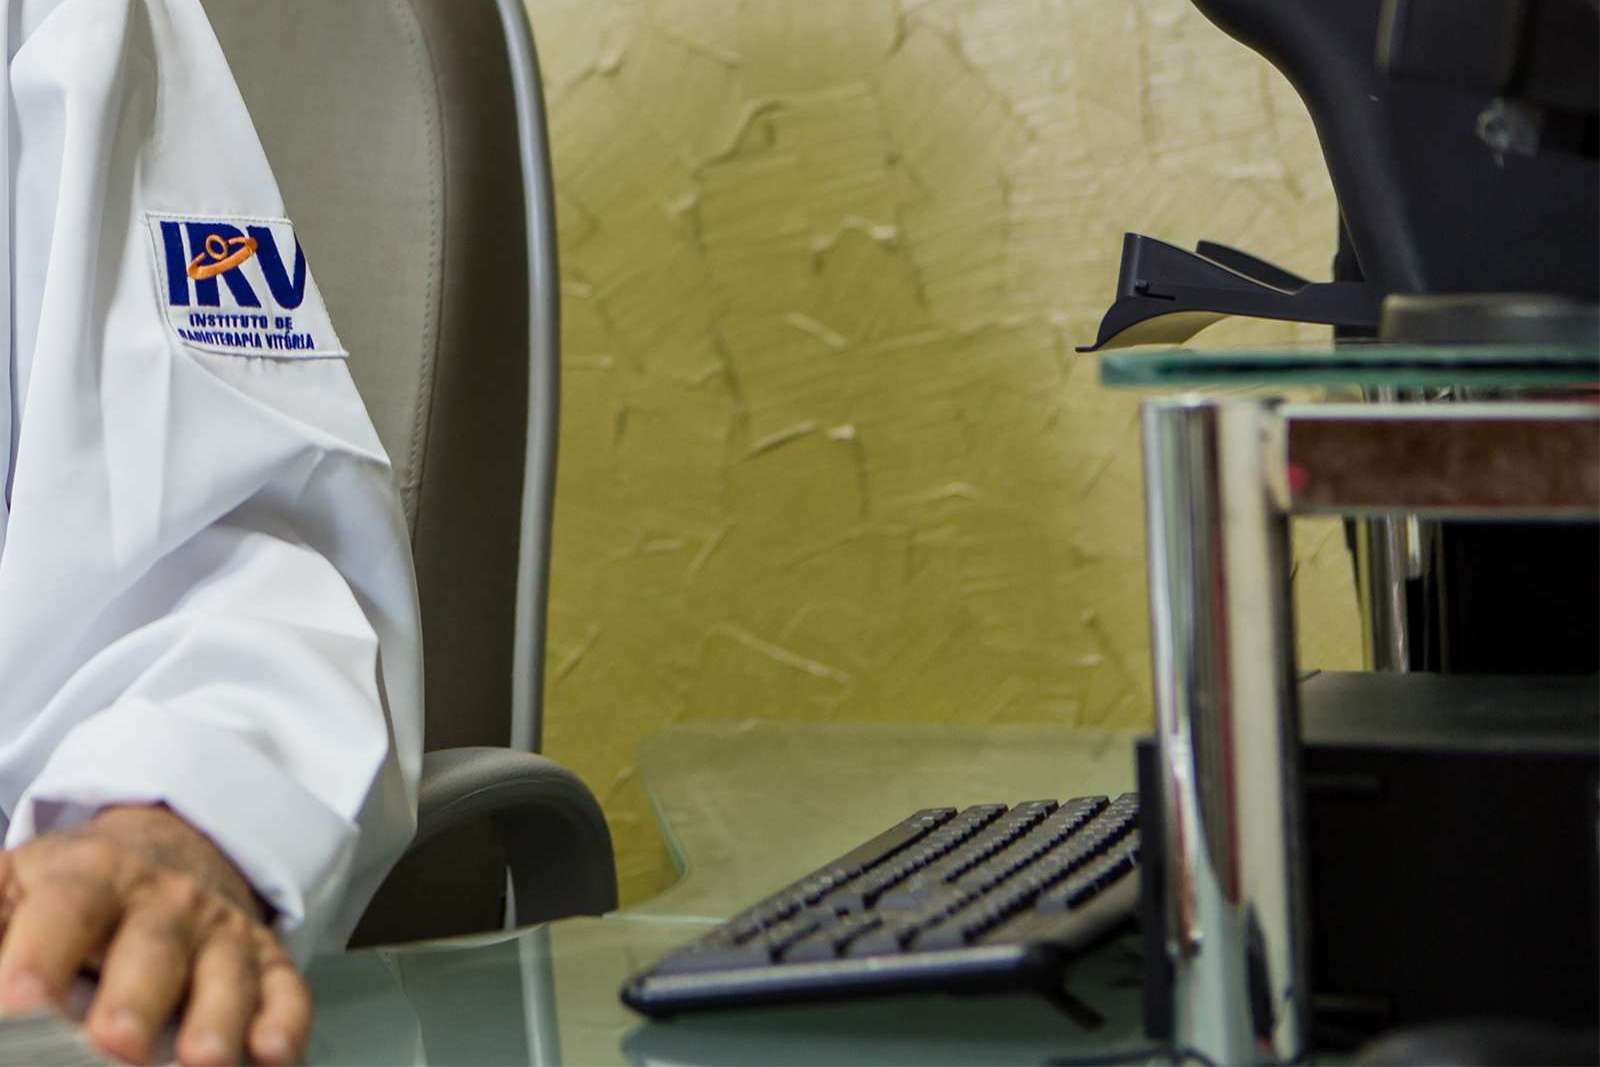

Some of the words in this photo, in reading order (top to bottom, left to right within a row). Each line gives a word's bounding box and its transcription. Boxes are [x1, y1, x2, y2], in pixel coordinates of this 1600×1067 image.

[160, 221, 307, 311] IRV
[189, 313, 268, 329] INSTITUTO
[275, 316, 294, 330] DE
[178, 328, 262, 349] RADIOTERAPIA
[265, 330, 315, 350] VITÓRIA
